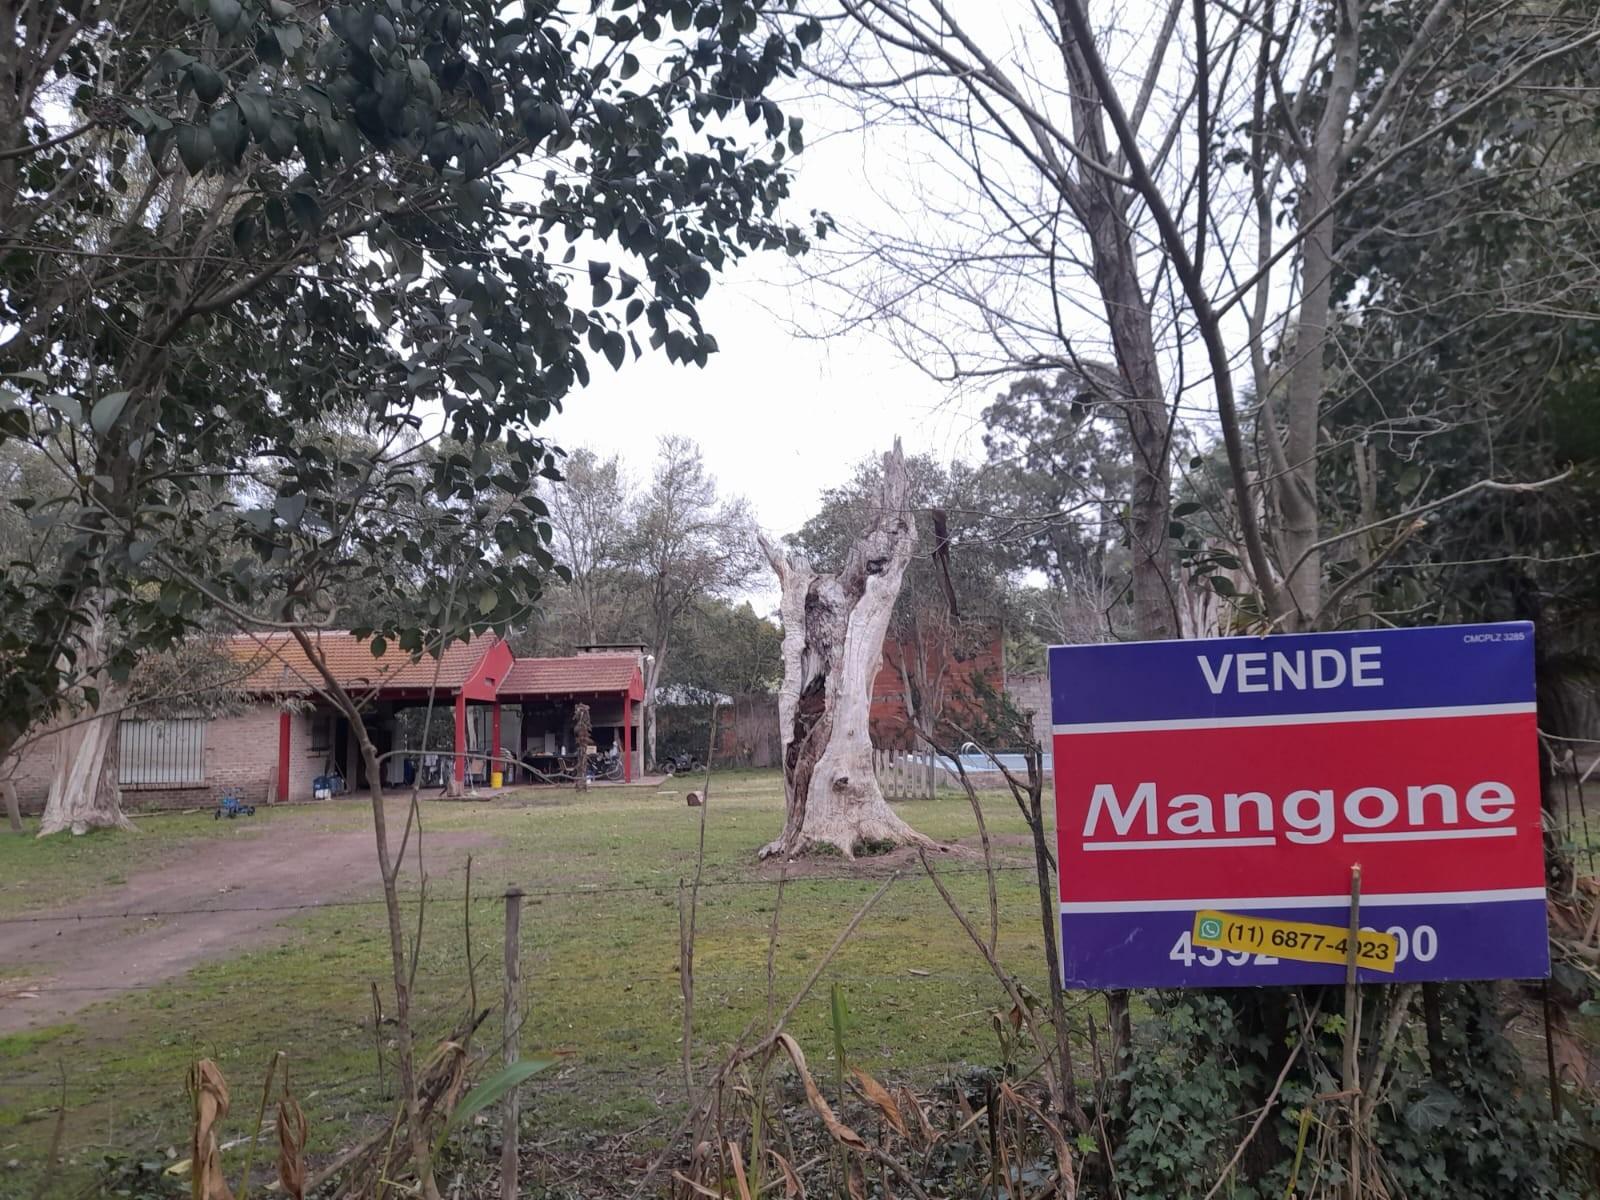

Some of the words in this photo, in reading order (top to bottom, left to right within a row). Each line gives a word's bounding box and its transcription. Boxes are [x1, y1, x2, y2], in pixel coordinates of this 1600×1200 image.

[1197, 646, 1384, 694] VENDE
[1082, 781, 1516, 844] Mangone
[1227, 922, 1264, 947] (11)
